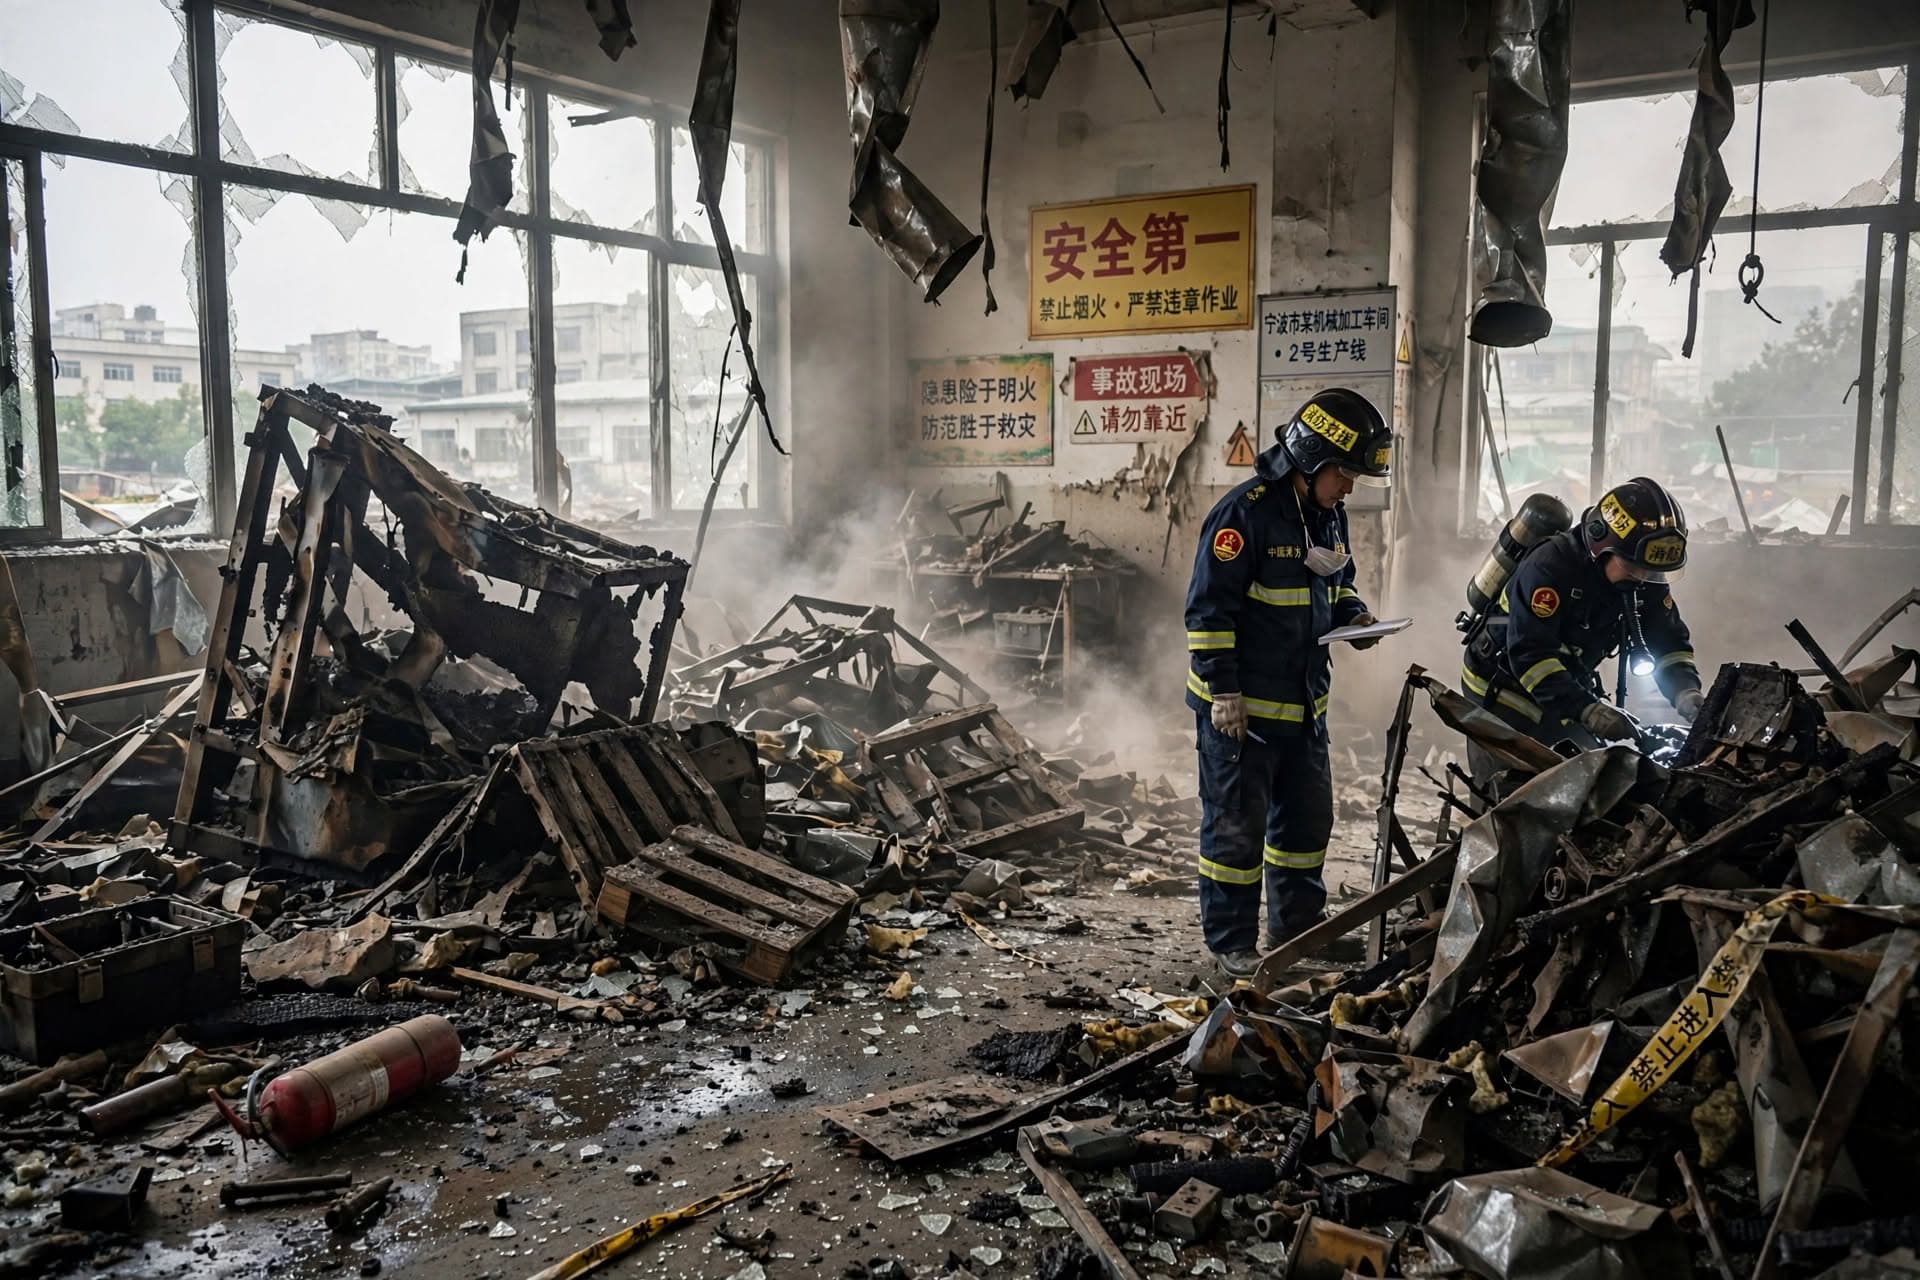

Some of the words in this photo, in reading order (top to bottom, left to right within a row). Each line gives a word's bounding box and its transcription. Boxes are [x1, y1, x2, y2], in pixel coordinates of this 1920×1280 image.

[1043, 211, 1240, 283] 安全第一
[1264, 306, 1389, 335] 宁波市某机械加工车间
[1091, 364, 1187, 395] 事故现场
[921, 412, 1037, 440] 防范胜于救灾
[1101, 404, 1187, 433] 请勿靠近
